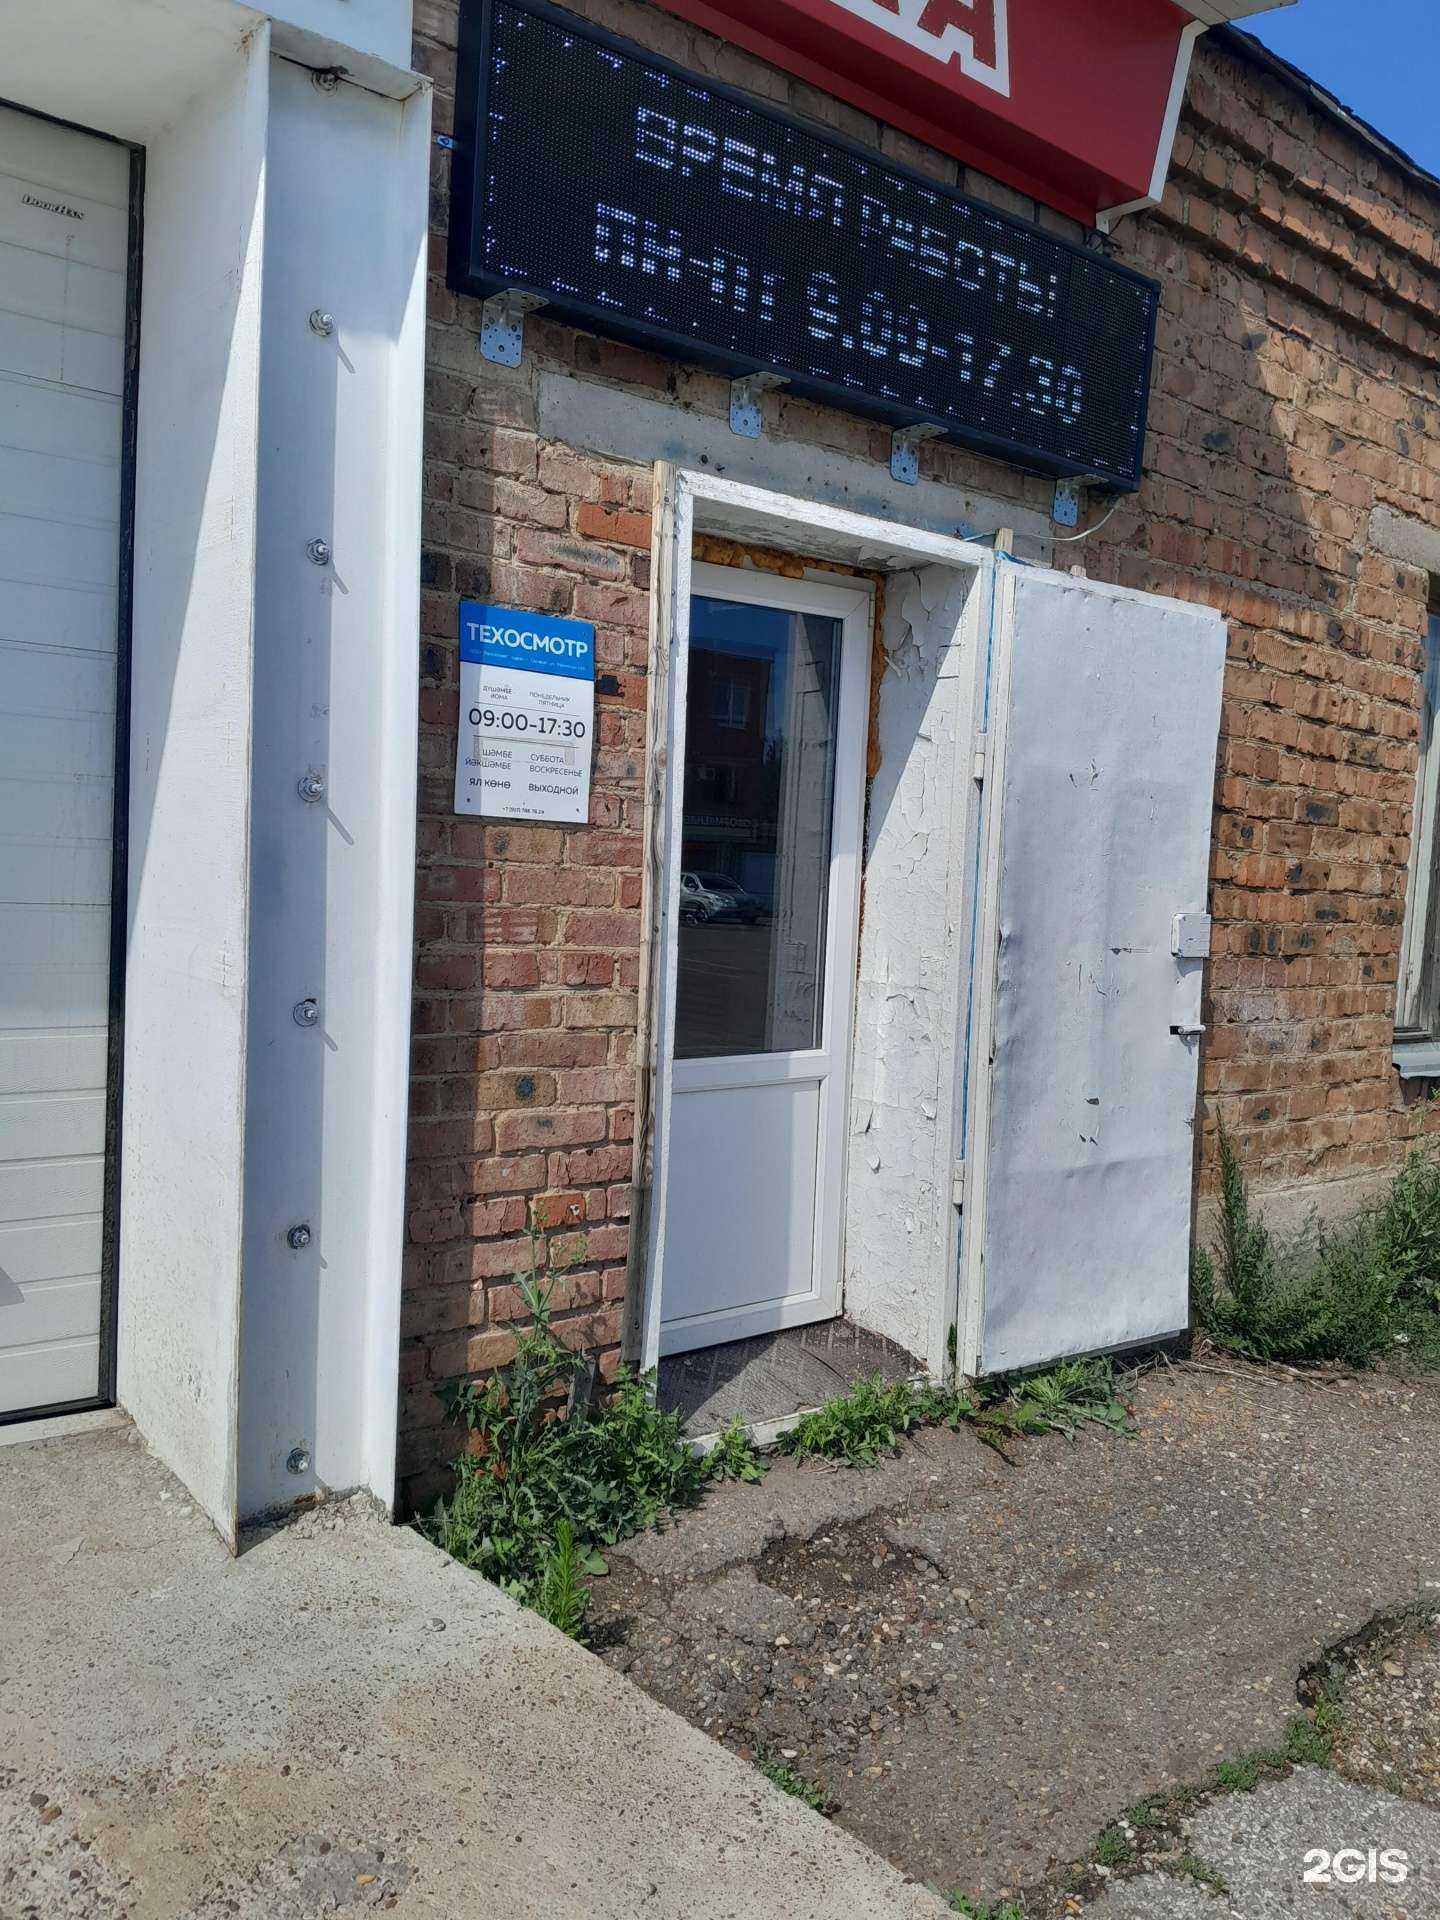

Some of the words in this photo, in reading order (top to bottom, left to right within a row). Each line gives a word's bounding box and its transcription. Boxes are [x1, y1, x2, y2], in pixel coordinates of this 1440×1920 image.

[466, 622, 589, 658] ТЕХОСМОТР
[468, 707, 586, 739] 09:00-17:30
[530, 753, 564, 764] СУББОТА
[529, 765, 584, 778] ВОСКРЕСЕНЬЕ
[468, 777, 482, 787] ЯЛ
[484, 778, 511, 790] КӨНӨ
[528, 782, 579, 796] ВЫХОДНОЙ
